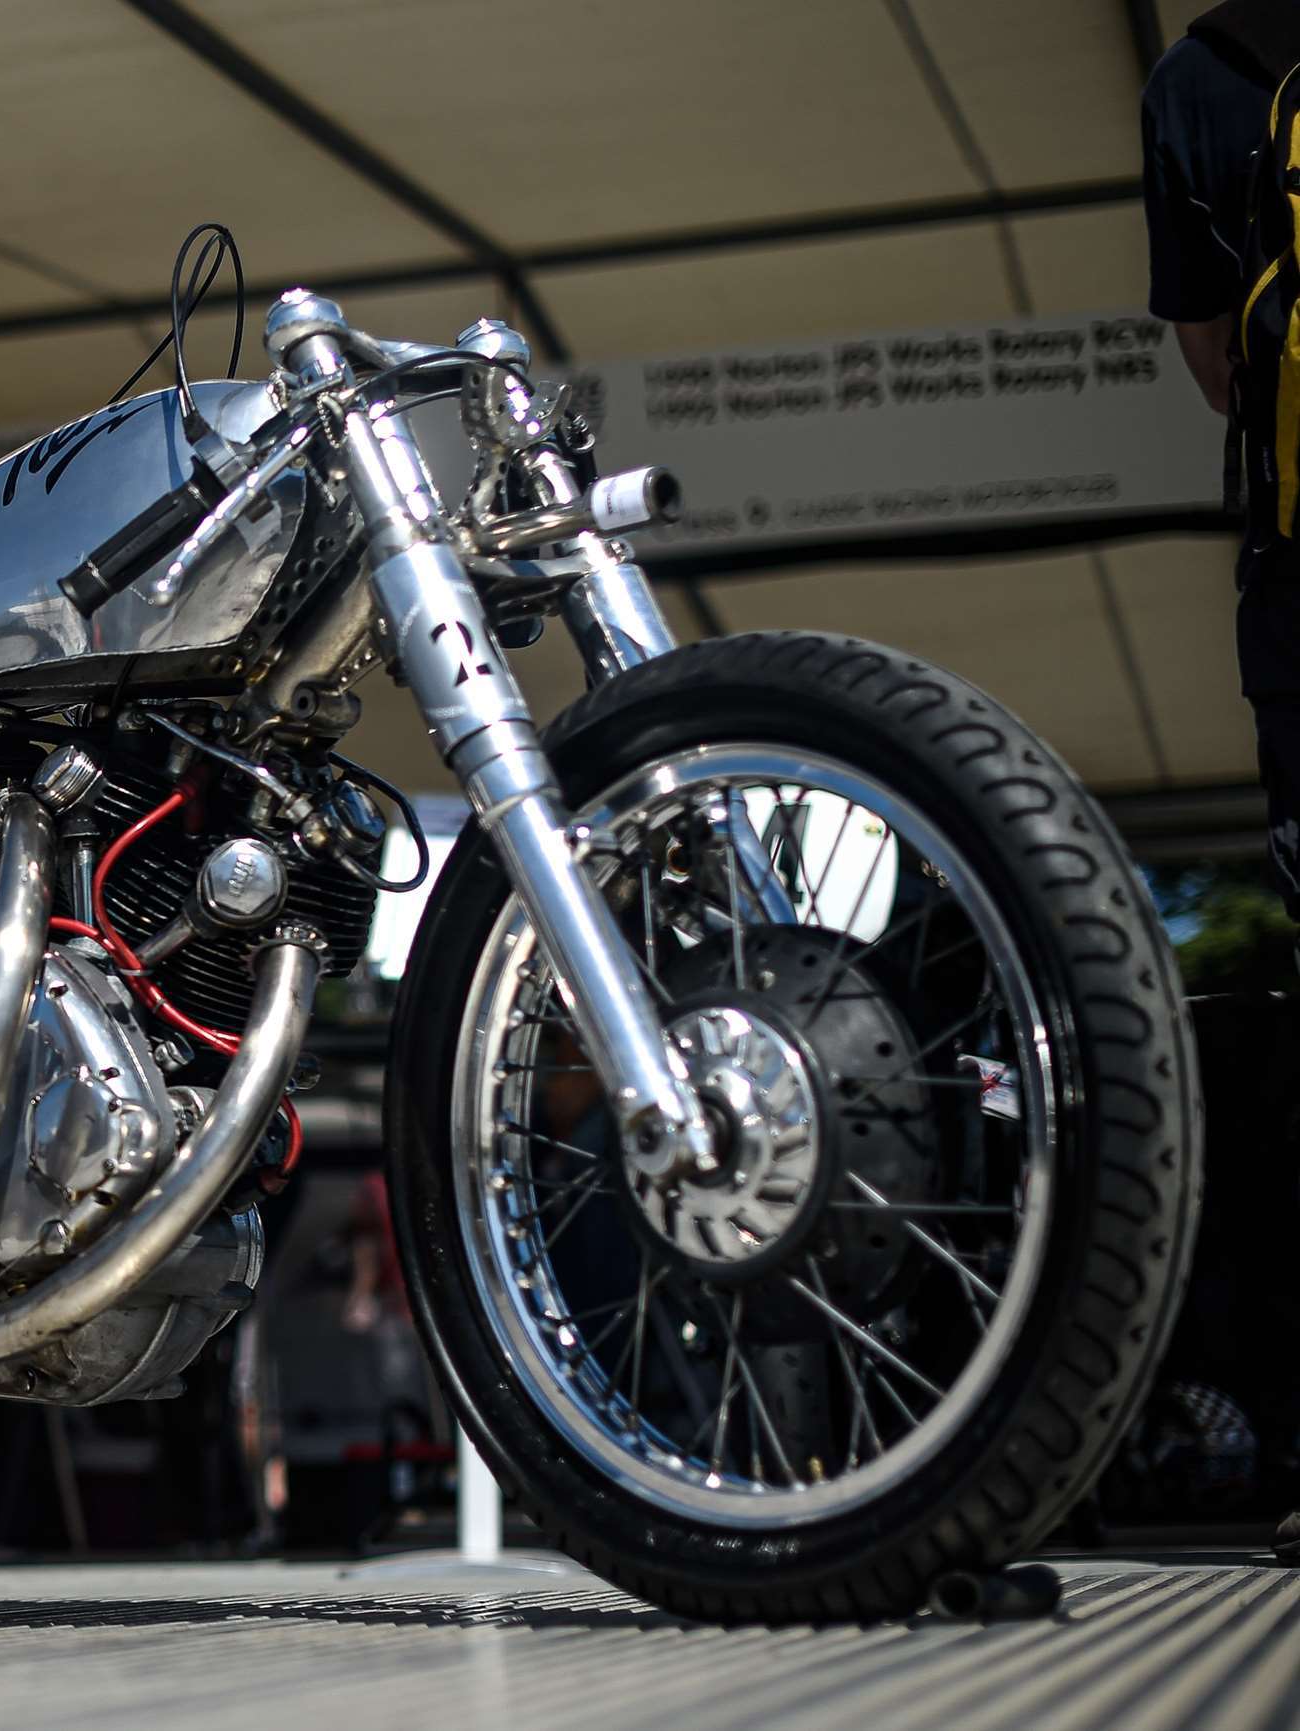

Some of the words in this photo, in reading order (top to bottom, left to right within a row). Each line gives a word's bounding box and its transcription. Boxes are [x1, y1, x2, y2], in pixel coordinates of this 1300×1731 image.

[721, 349, 826, 385] Norton
[834, 342, 881, 373] JPS
[888, 333, 982, 370] Works
[989, 328, 1085, 361] Rotary
[726, 382, 830, 421] Norton
[837, 374, 885, 410] JPS
[889, 365, 985, 403] Works
[992, 361, 1088, 394] Rotary
